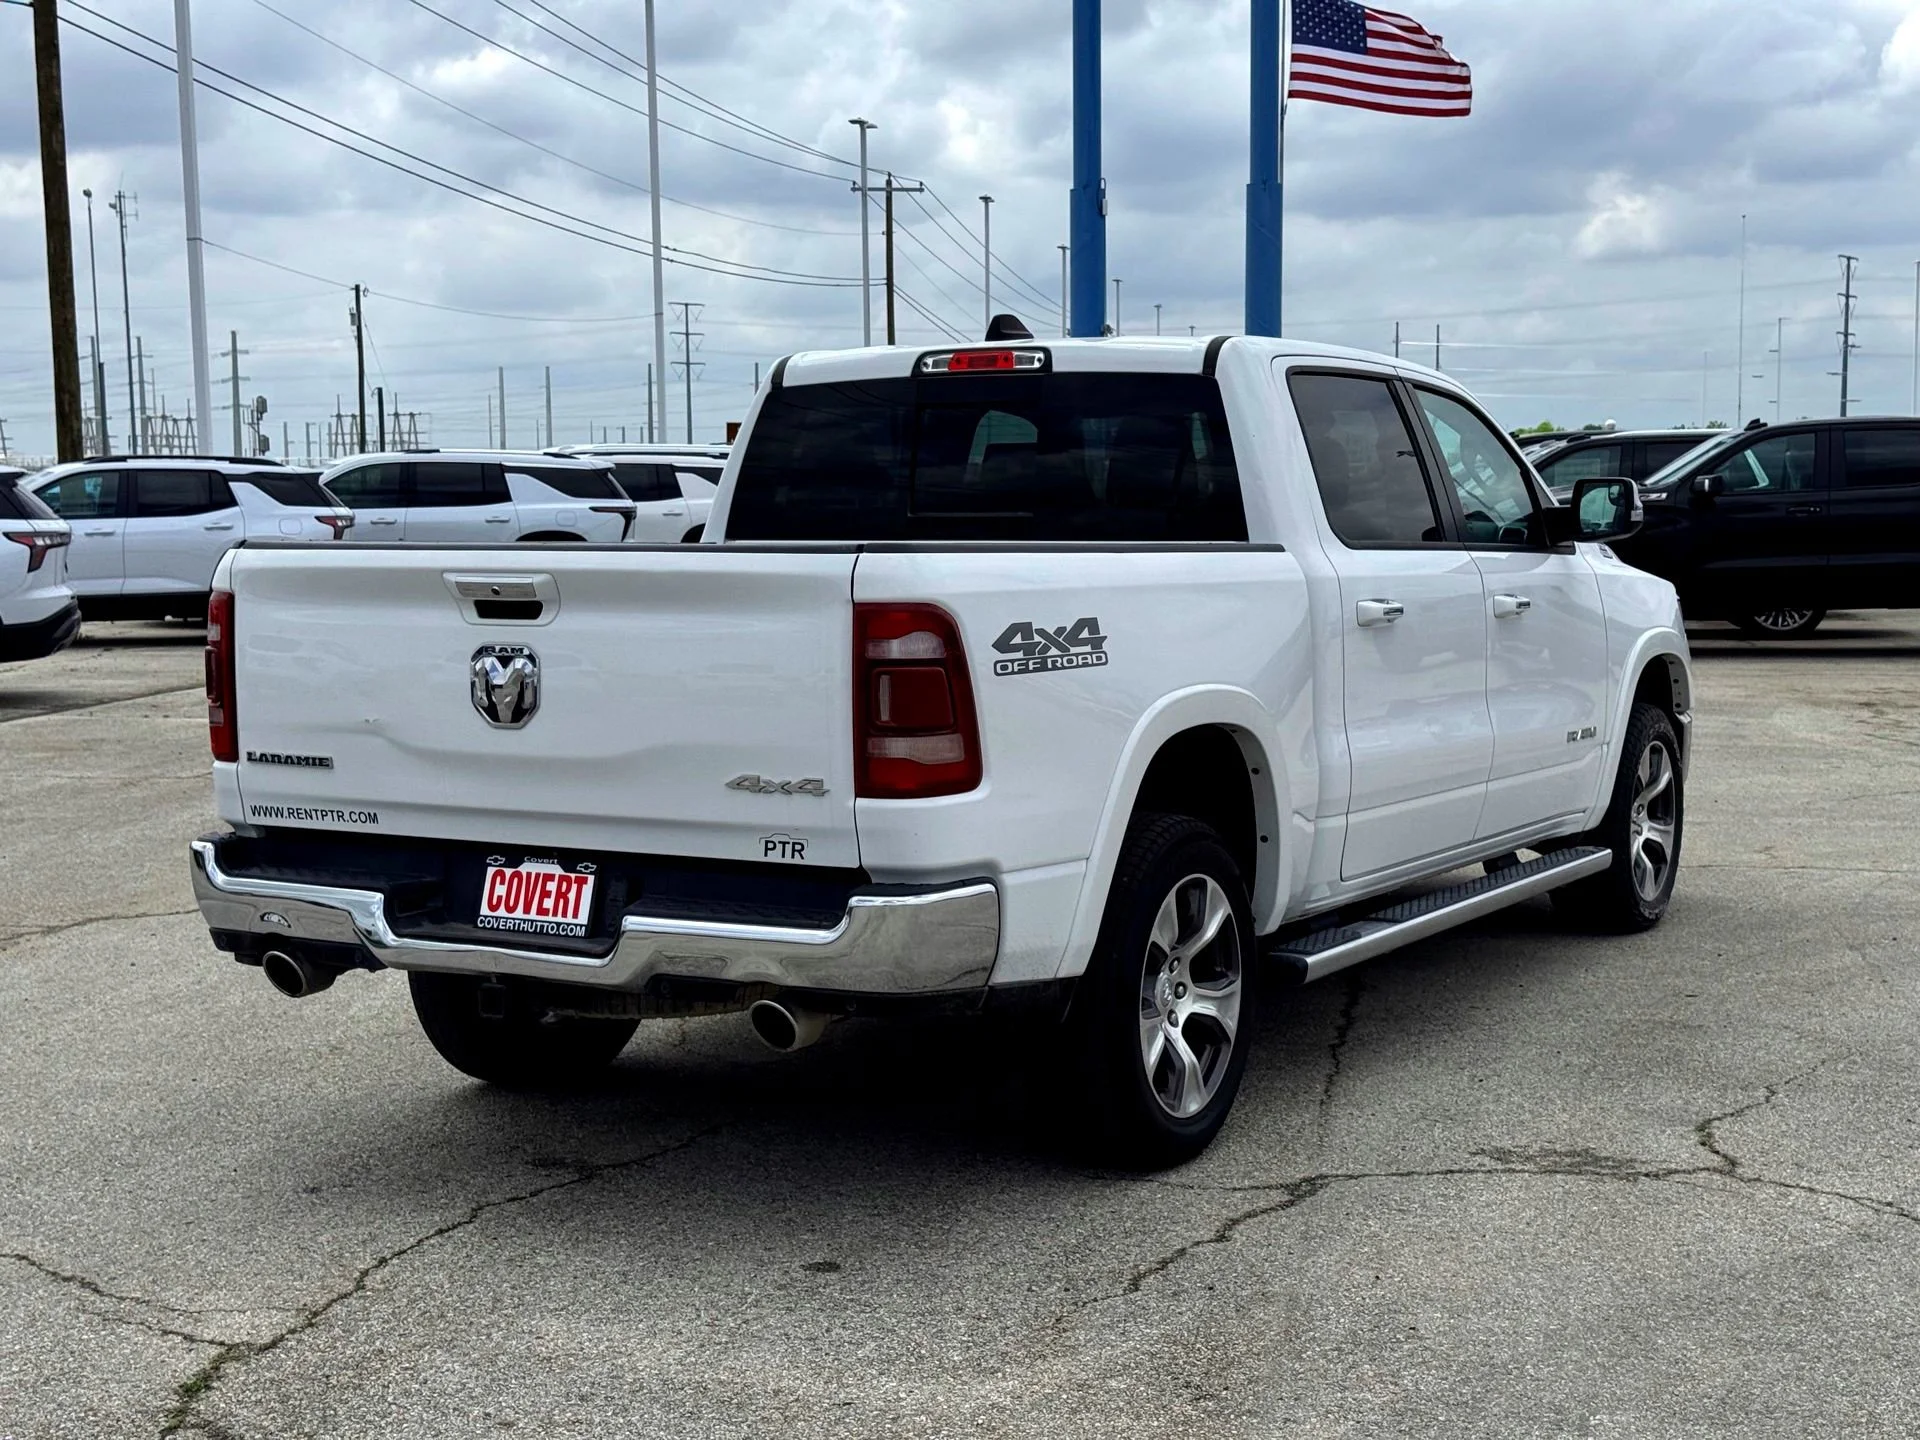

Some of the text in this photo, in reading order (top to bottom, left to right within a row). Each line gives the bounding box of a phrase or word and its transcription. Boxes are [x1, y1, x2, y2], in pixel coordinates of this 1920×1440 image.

[483, 645, 525, 656] RAM
[996, 653, 1107, 674] OFF ROAD
[246, 751, 334, 769] LARAMIE
[250, 804, 379, 825] WWW.RENTPTR.COM
[763, 839, 805, 860] PTR
[487, 868, 589, 920] COVERT
[477, 916, 586, 937] COVERTHUTTO.COM
